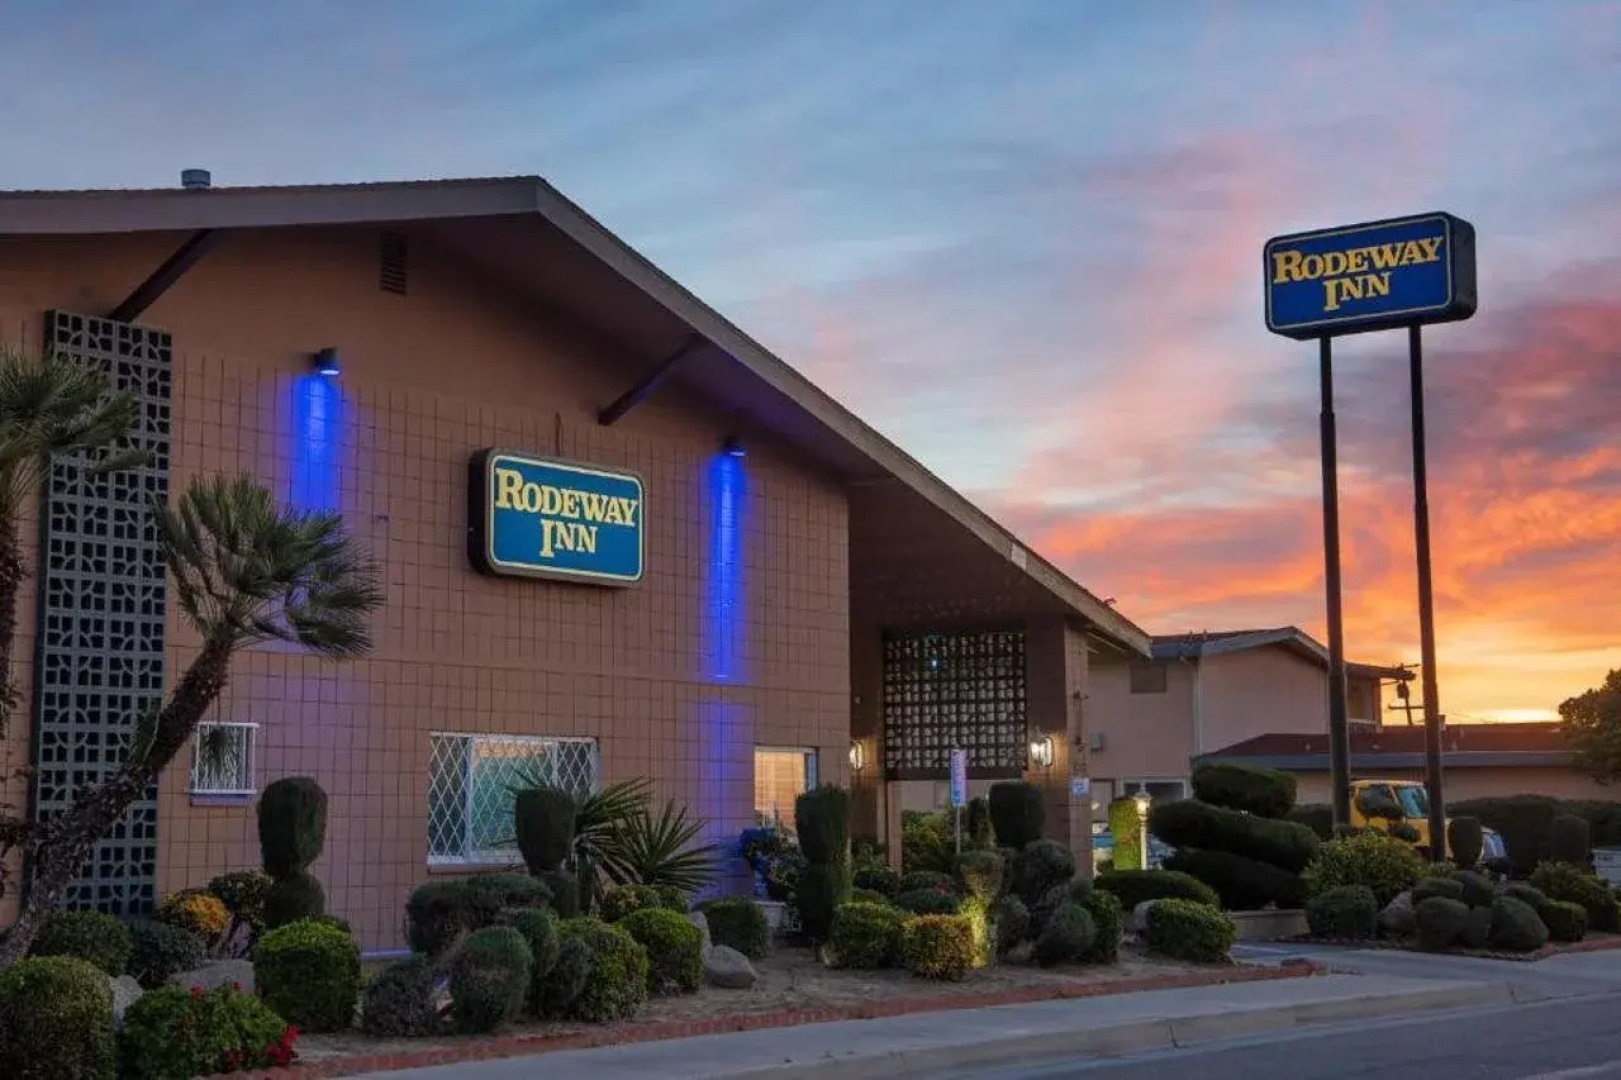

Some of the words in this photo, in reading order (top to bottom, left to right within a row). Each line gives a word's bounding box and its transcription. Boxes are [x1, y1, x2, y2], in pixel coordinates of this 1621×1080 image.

[1273, 236, 1443, 284] RODEWAY
[1322, 271, 1391, 311] INN
[495, 468, 638, 527] RODEWAY
[540, 519, 598, 557] INN
